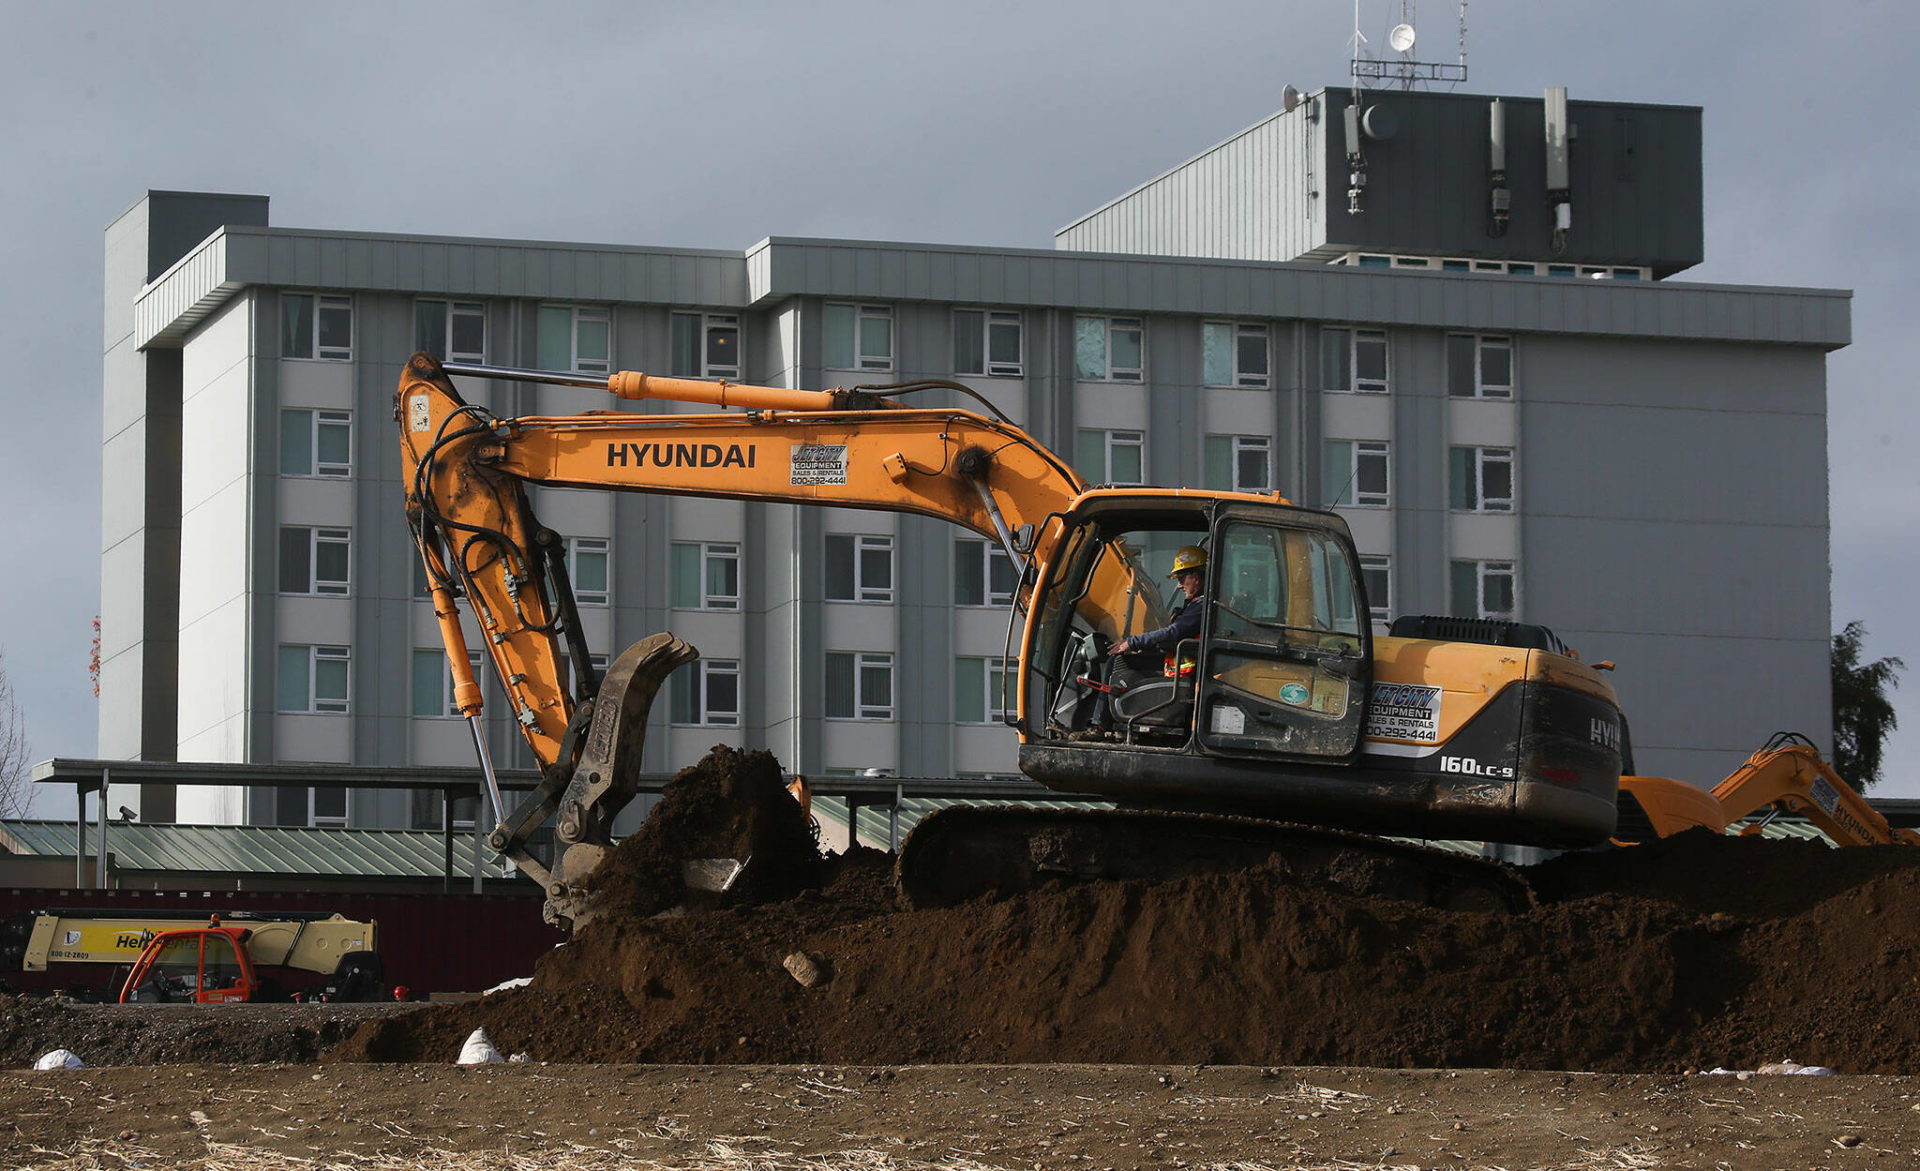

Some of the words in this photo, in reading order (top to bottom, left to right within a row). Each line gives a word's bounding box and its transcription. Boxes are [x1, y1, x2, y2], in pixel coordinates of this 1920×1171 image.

[607, 443, 756, 468] HYUNDAI
[791, 477, 846, 485] 800-292-4441
[1389, 718, 1396, 726] &
[1398, 719, 1434, 729] RENTALS
[1366, 726, 1436, 741] 00-292-4441
